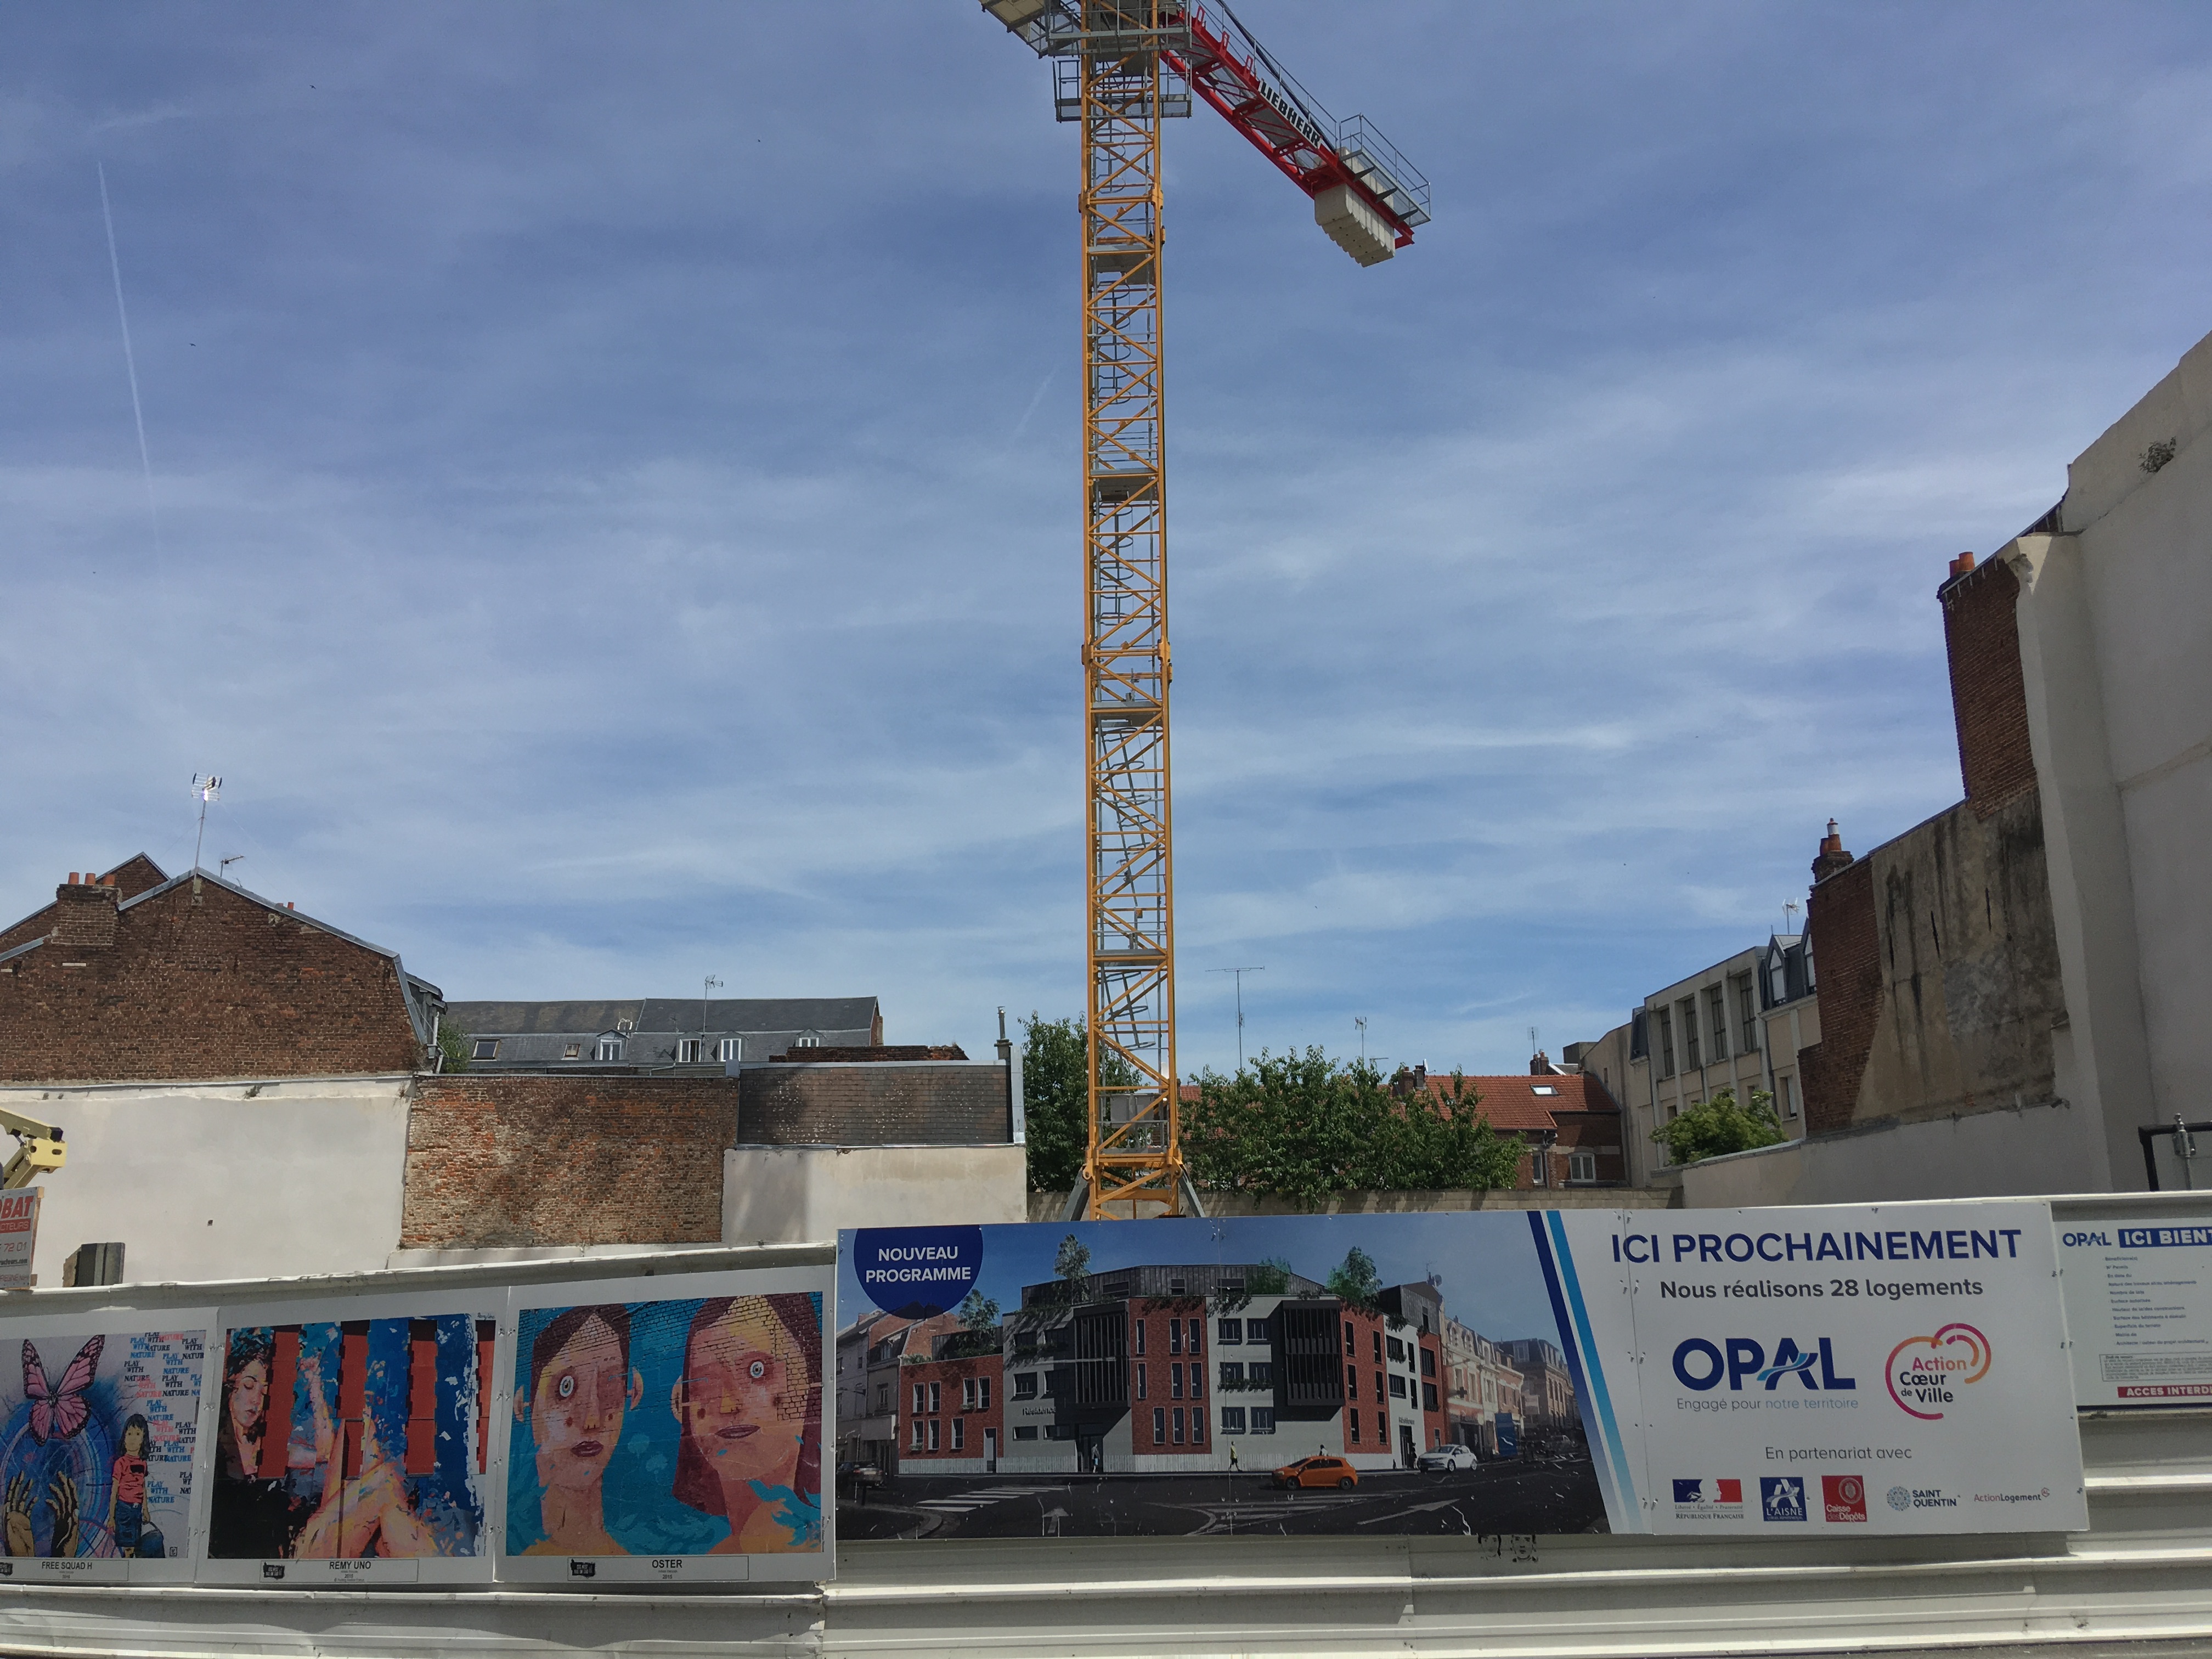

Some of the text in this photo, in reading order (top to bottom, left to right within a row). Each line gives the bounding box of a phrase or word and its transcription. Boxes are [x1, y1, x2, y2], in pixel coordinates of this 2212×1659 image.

[1260, 81, 1320, 148] LIEBHERR
[2062, 1232, 2112, 1246] OPAL
[2124, 1231, 2152, 1245] ICI
[1612, 1229, 2022, 1263] ICI PROCHAINEMENT
[878, 1246, 958, 1261] NOUVEAU
[866, 1267, 971, 1283] PROGRAMME
[1661, 1279, 1984, 1301] Nous réalisons 28 logements
[1672, 1337, 1857, 1391] OPAL
[1912, 1356, 1967, 1372] Action
[1900, 1372, 1946, 1386] Cœur
[1901, 1387, 1954, 1404] de Ville
[2126, 1387, 2164, 1397] ACCES
[1677, 1397, 1859, 1413] Engagé pour notre territoire
[1765, 1447, 1912, 1462] En partenariat avec
[1912, 1489, 1942, 1498] SAINT
[1913, 1498, 1957, 1508] QUENTIN
[1766, 1508, 1803, 1516] L'AISNE
[42, 1561, 59, 1570] FREE
[61, 1561, 86, 1570] SQUAD
[329, 1561, 371, 1570] REMY UNO
[652, 1559, 682, 1568] OSTER
